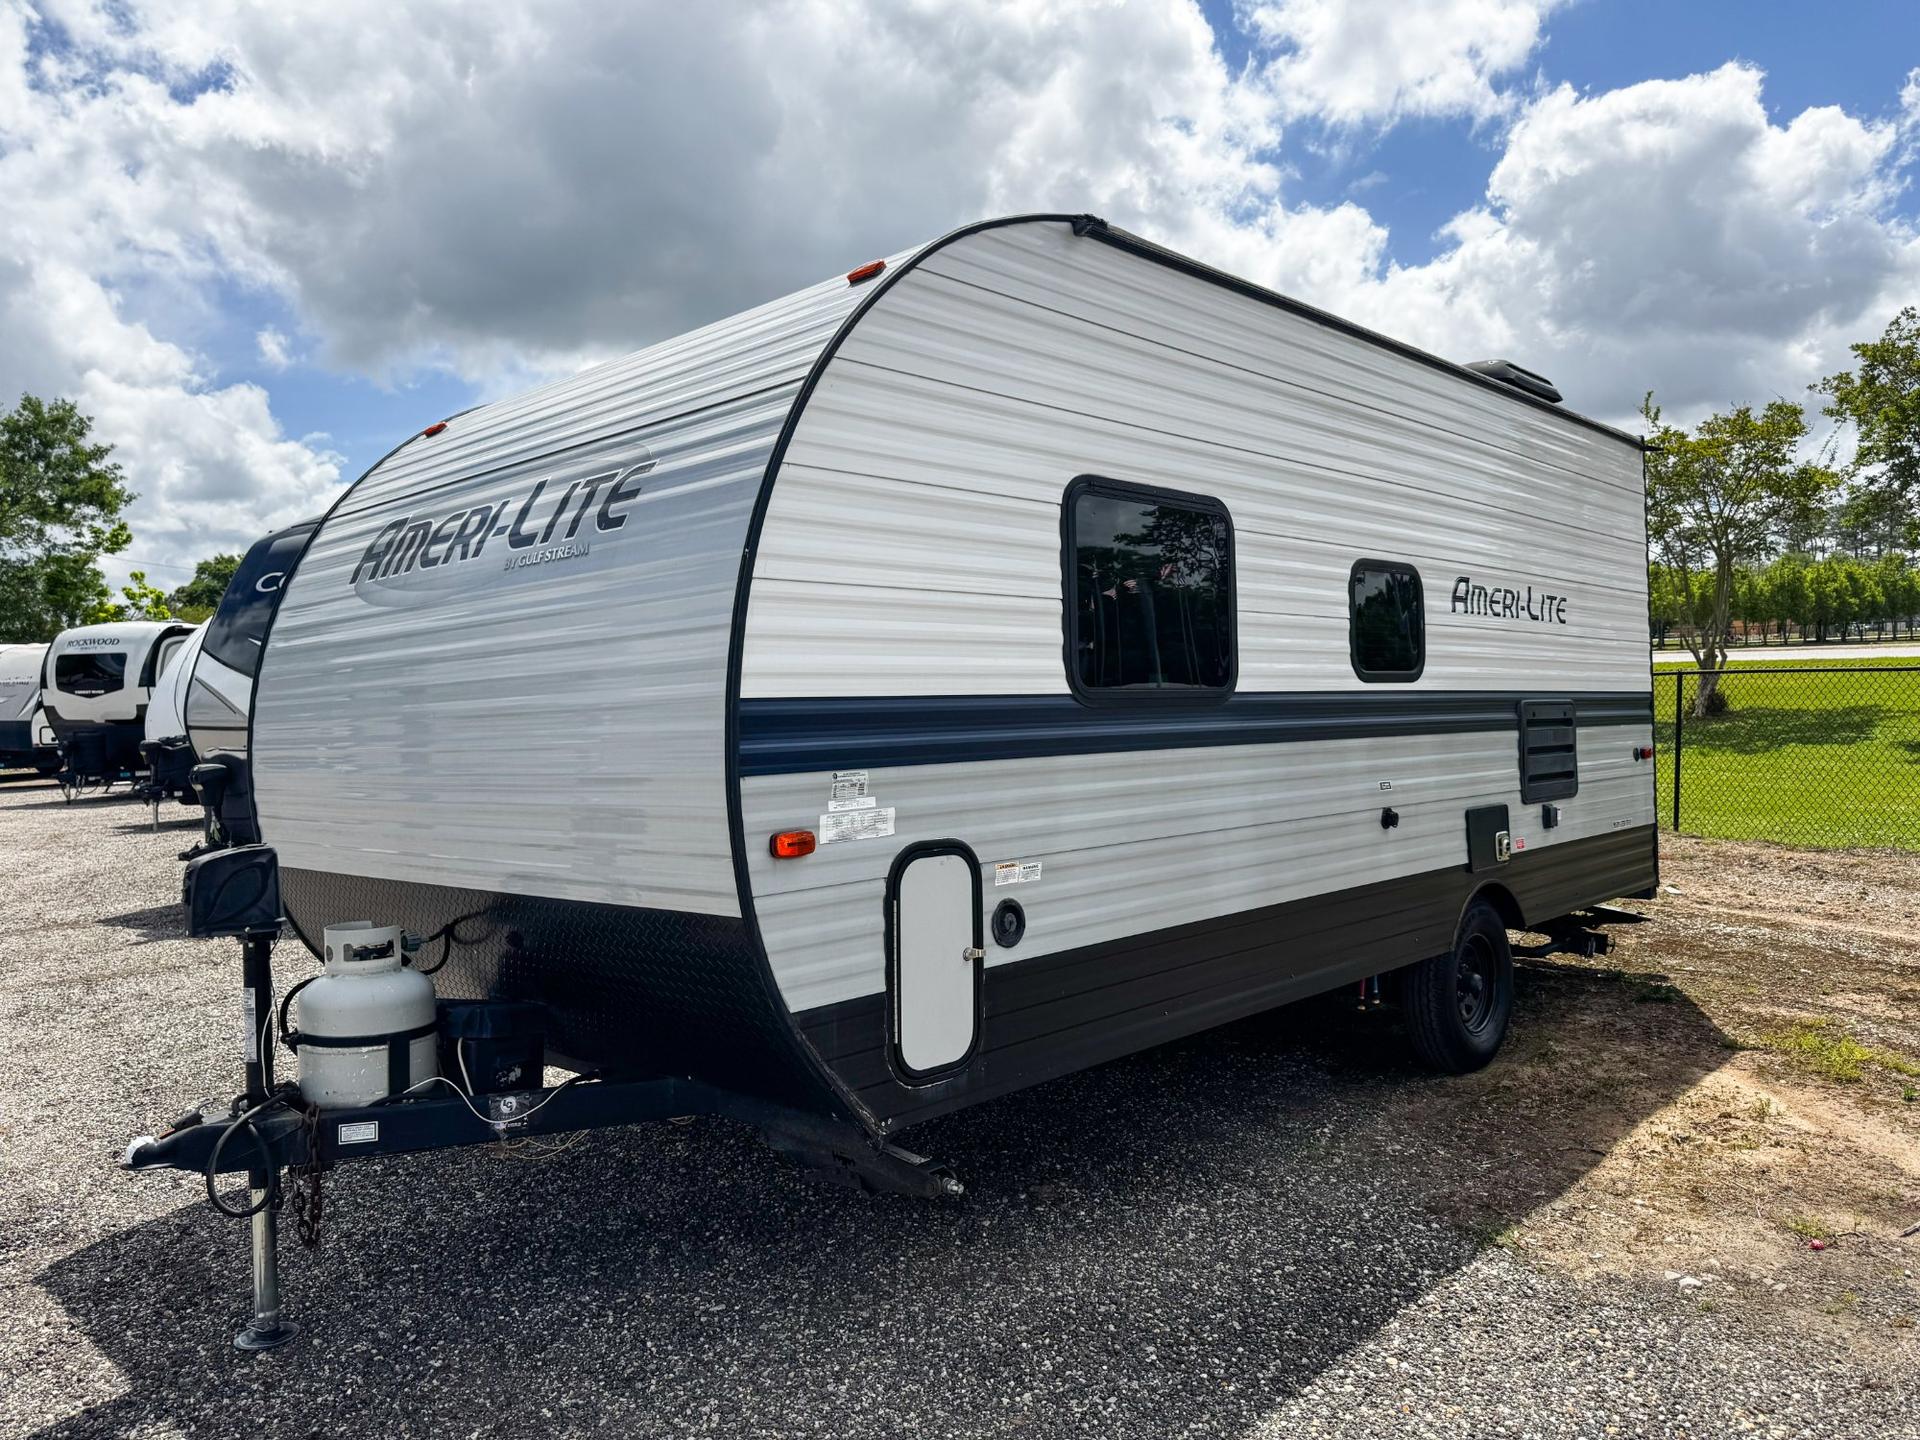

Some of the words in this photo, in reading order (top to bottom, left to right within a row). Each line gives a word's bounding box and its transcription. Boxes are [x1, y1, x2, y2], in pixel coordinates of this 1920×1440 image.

[349, 459, 660, 586] AMERI-LITE
[518, 552, 545, 567] GULF
[545, 542, 590, 563] STREAM
[1452, 577, 1567, 624] AMERI-LITE
[66, 638, 120, 647] ROCKWOOD
